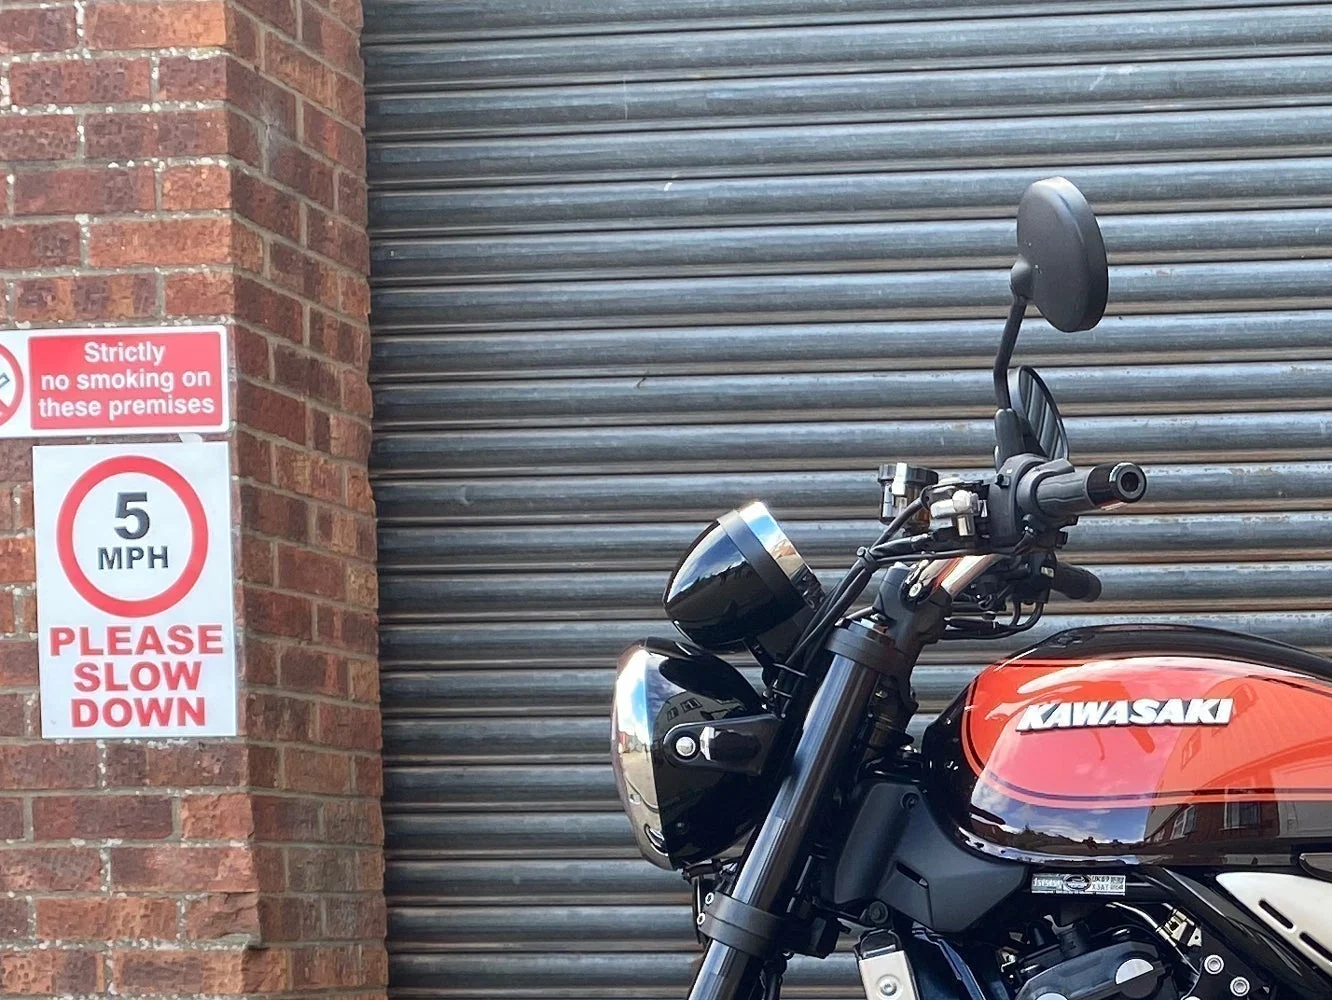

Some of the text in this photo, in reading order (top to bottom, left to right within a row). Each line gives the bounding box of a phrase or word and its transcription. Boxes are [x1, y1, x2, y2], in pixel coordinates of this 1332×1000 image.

[84, 341, 165, 366] Strictly
[41, 368, 211, 393] no smoking on
[38, 394, 214, 422] these premises
[113, 491, 150, 540] 5
[97, 545, 169, 570] MPH
[50, 624, 224, 657] PLEASE
[73, 660, 202, 693] SLOW
[71, 696, 206, 728] DOWN
[1015, 697, 1234, 732] KAWASAKI
